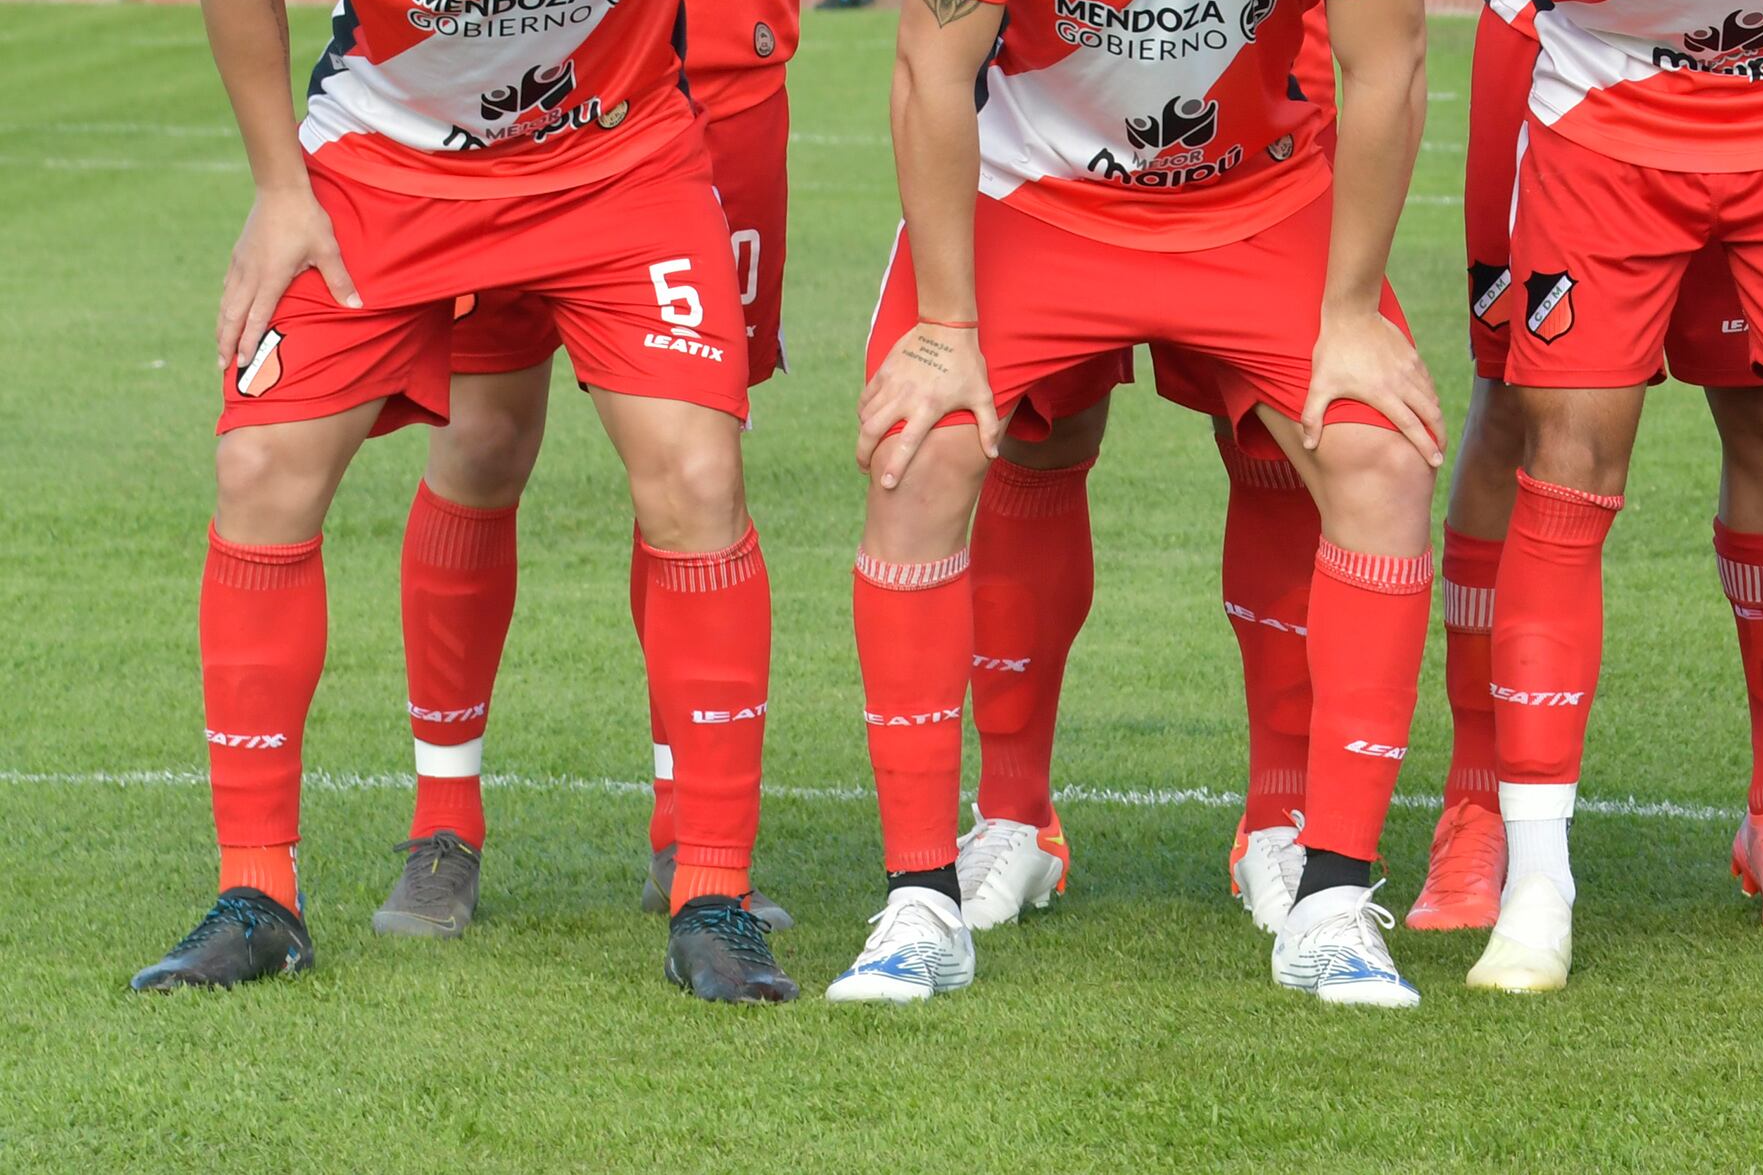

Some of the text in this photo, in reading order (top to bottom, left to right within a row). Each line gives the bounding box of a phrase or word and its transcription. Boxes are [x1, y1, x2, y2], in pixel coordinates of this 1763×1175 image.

[409, 4, 593, 39] GOBIERNO
[1055, 20, 1227, 61] GOBIERNO
[1087, 143, 1243, 191] maipú
[1131, 148, 1204, 170] MEJOR
[649, 258, 703, 328] 5
[1532, 286, 1564, 323] CDM
[644, 332, 725, 363] LEATIX
